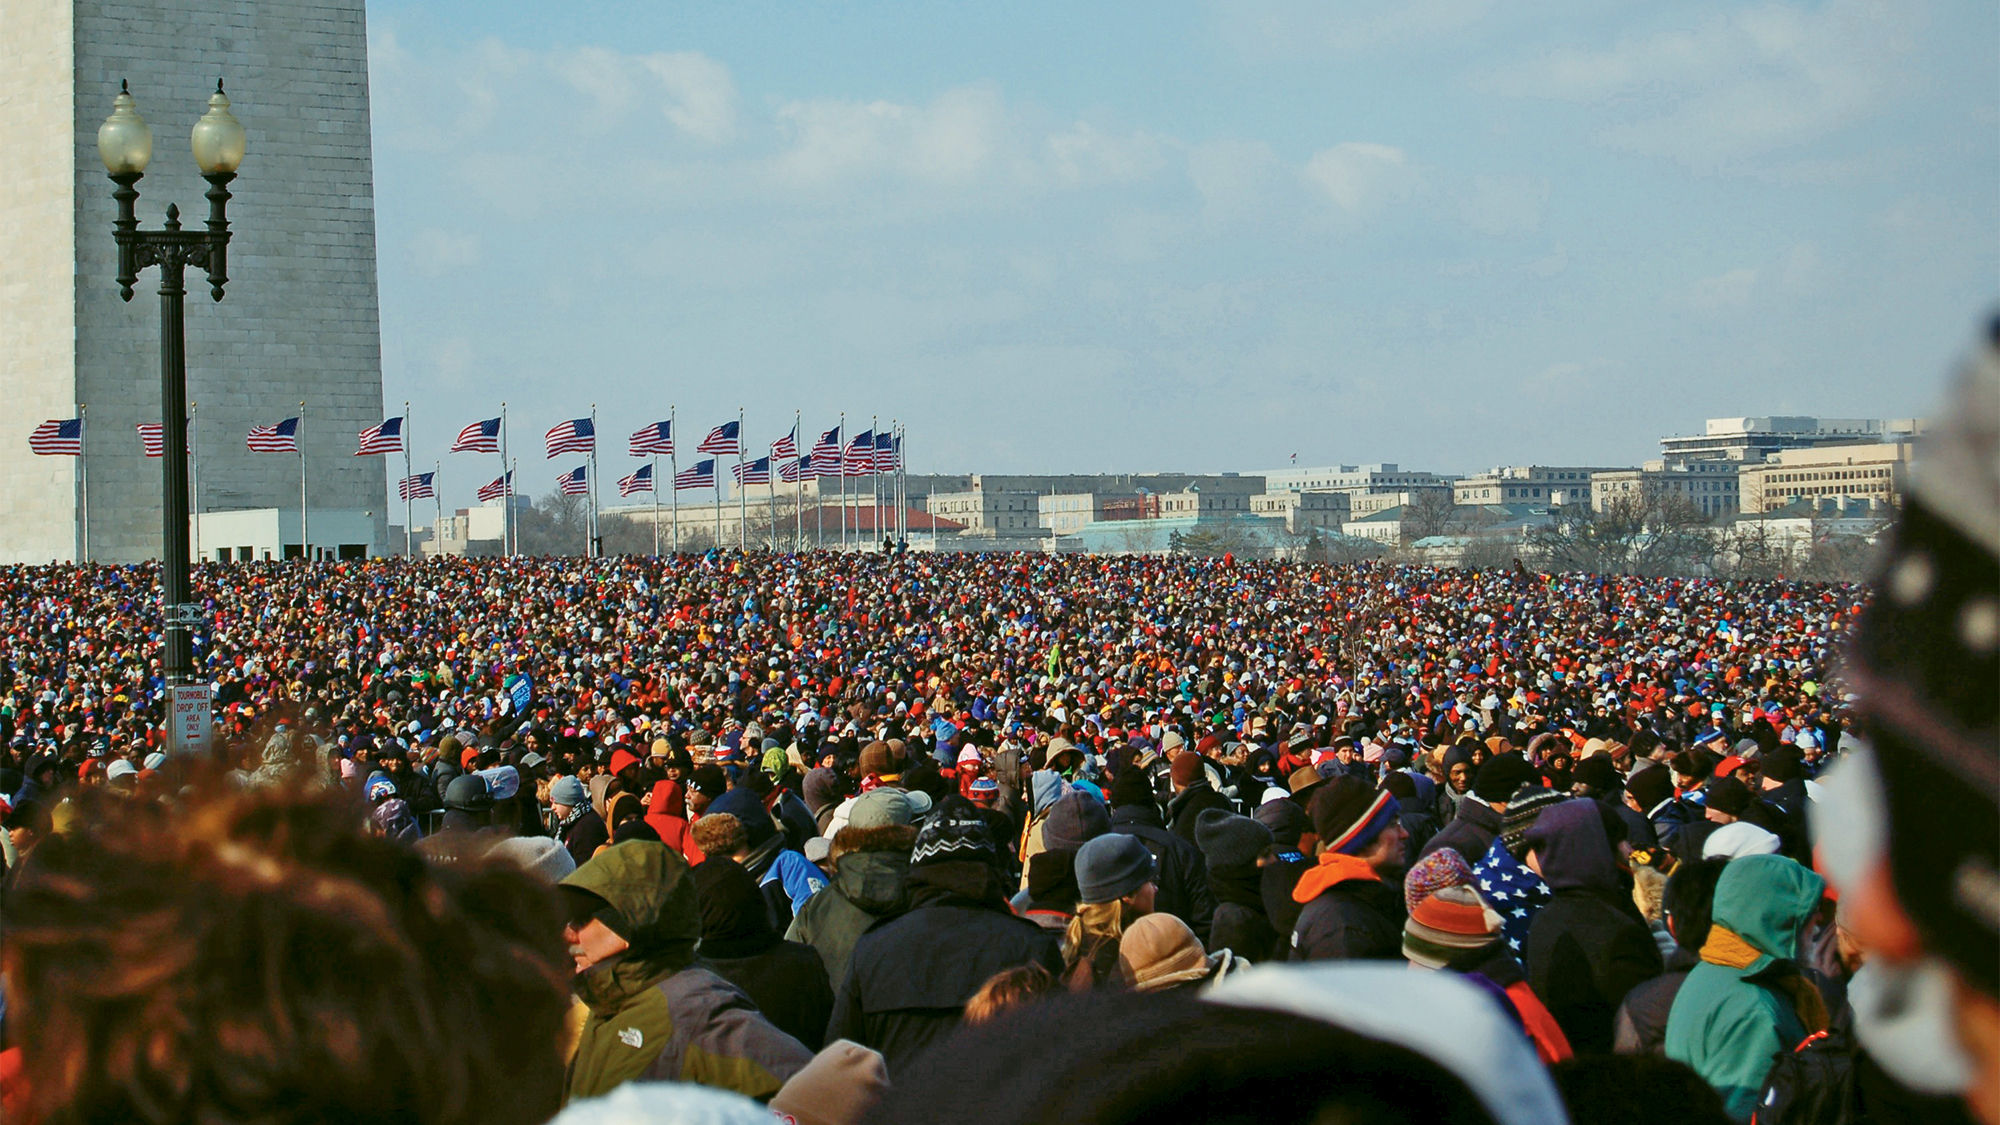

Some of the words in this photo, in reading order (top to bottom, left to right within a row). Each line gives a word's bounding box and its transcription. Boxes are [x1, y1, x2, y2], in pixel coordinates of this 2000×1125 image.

[177, 690, 208, 700] TOURMOBILE
[176, 703, 194, 713] DROP
[197, 702, 209, 712] OFF
[186, 714, 200, 722] AREA
[186, 723, 200, 731] ONLY
